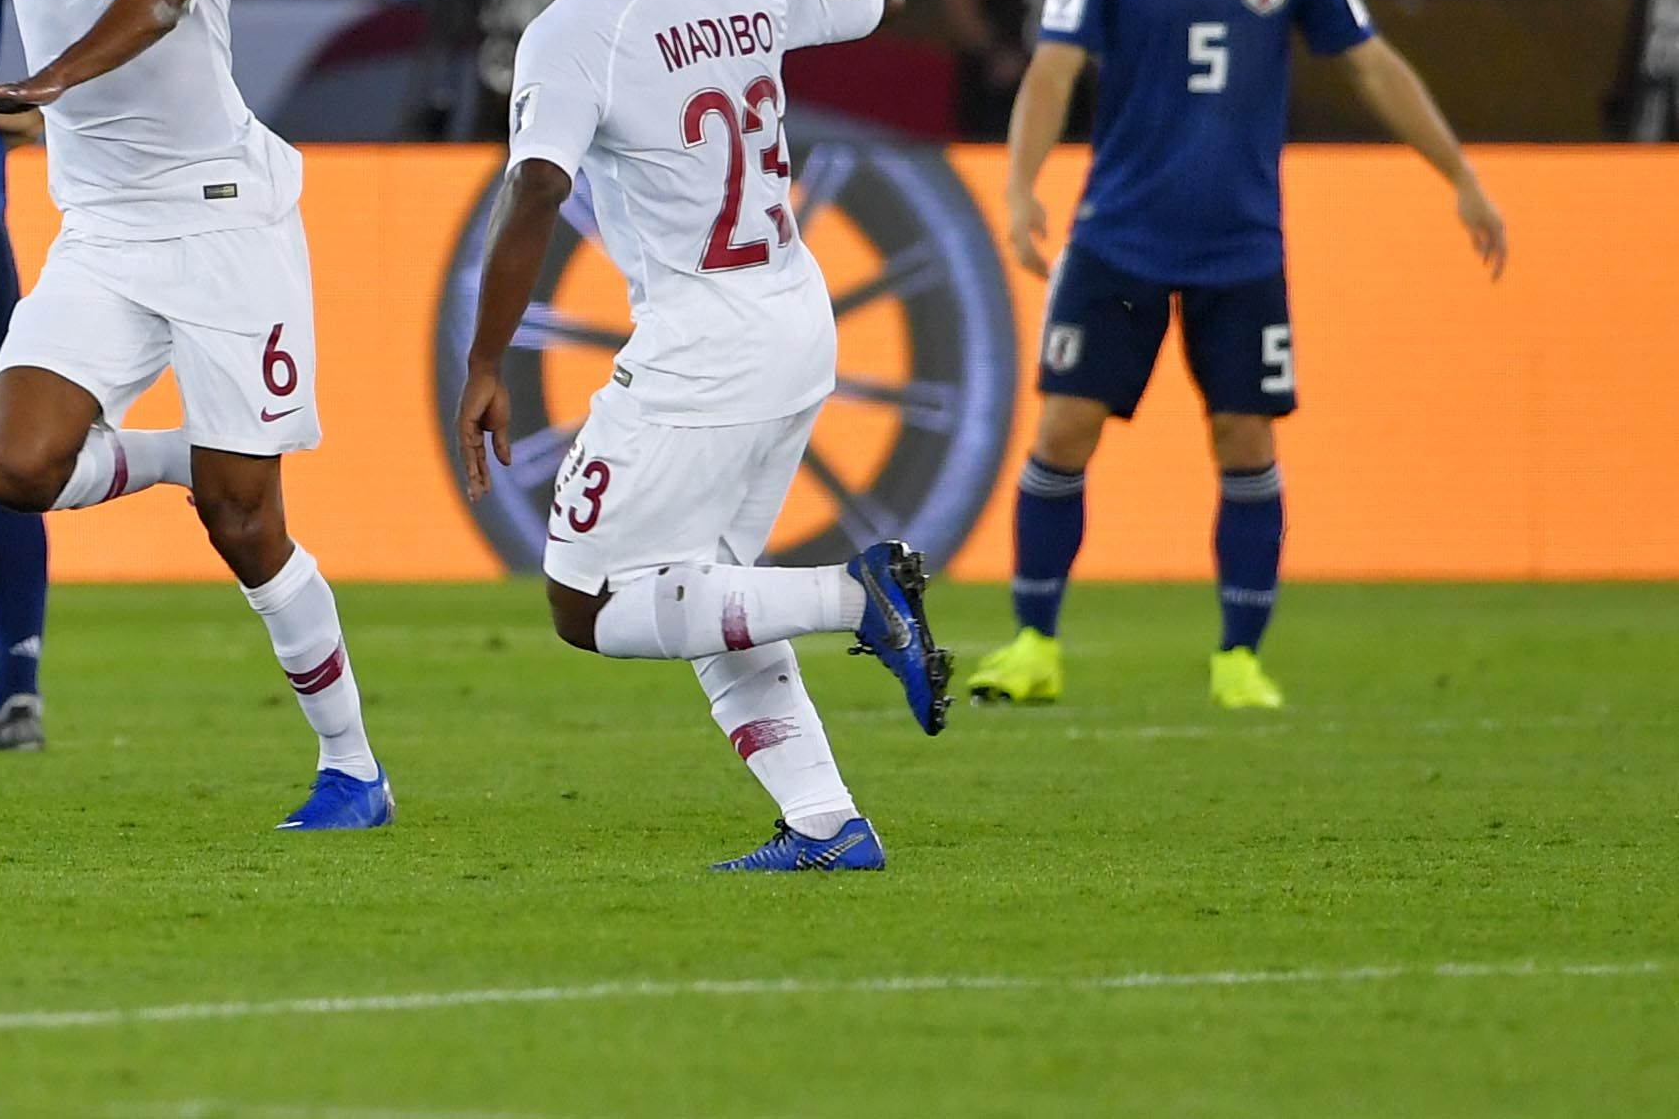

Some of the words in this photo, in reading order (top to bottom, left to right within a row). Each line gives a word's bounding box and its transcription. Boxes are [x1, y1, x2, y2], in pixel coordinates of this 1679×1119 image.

[655, 11, 773, 73] MADIBO
[1187, 21, 1230, 94] 5
[262, 322, 298, 397] 6
[1261, 324, 1295, 393] 5
